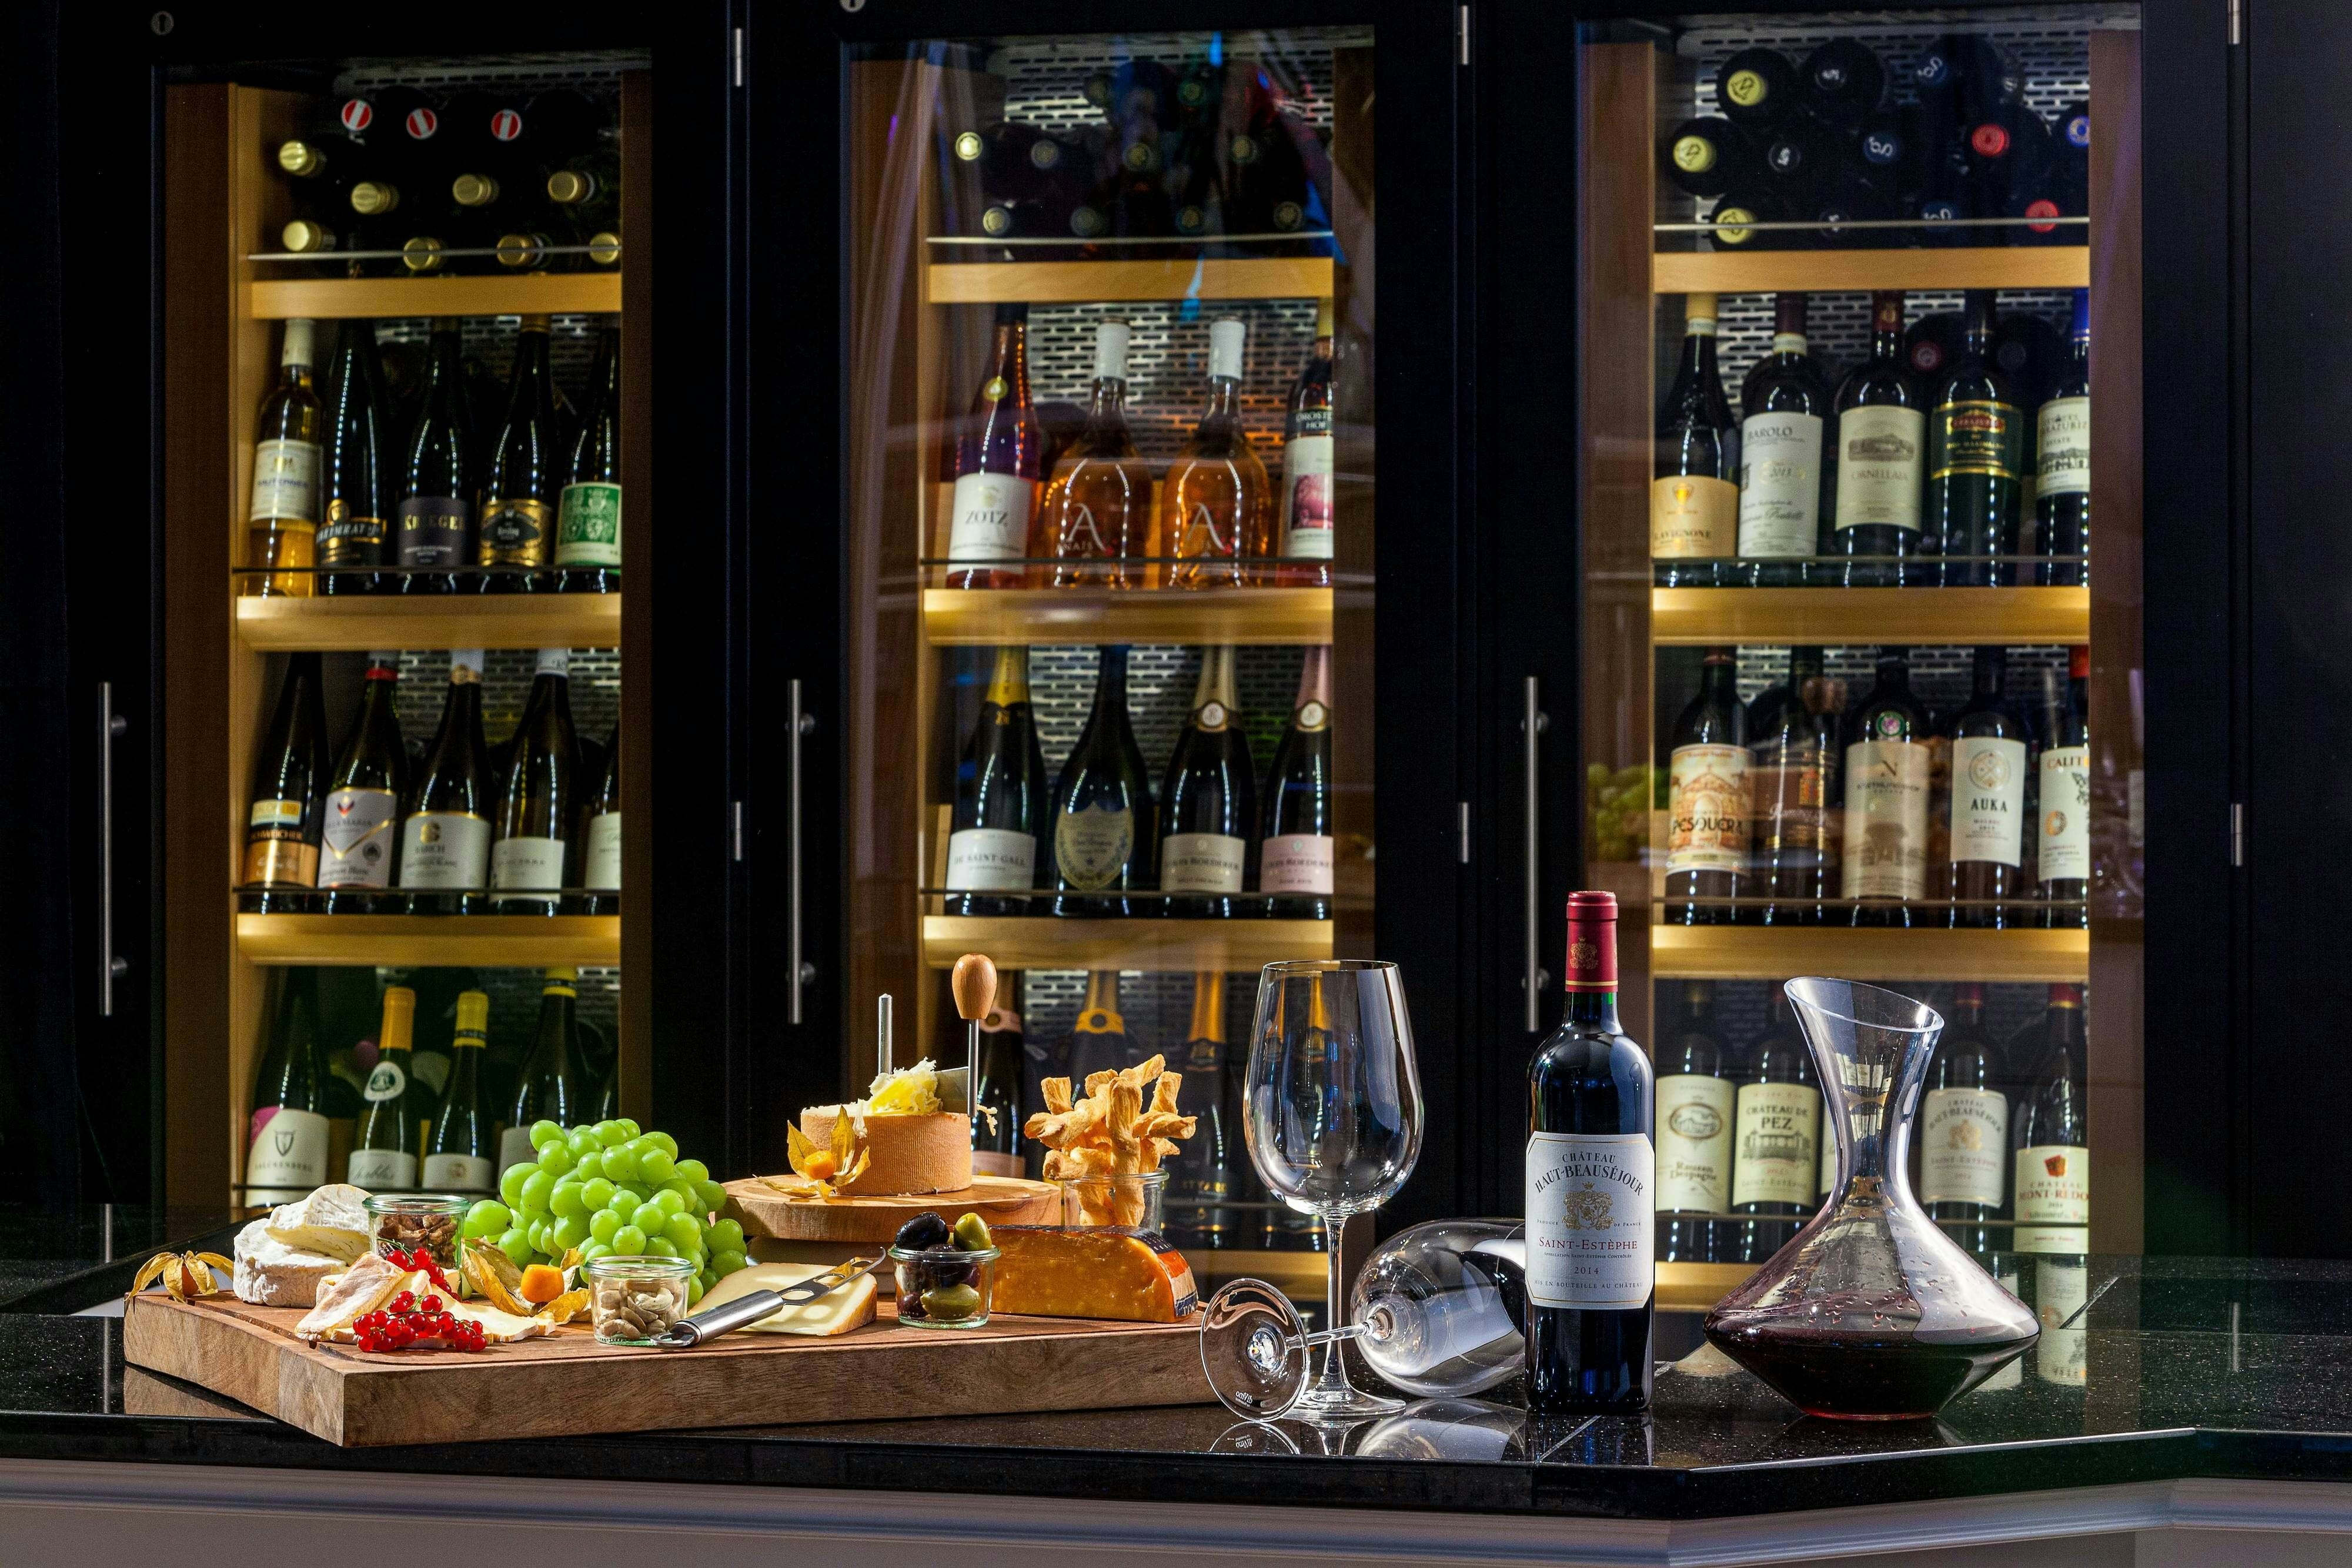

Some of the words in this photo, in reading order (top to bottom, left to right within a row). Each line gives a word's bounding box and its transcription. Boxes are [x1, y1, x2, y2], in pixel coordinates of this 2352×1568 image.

[1747, 426, 1793, 438] BAROLO
[965, 510, 1008, 525] ZOTZ
[1971, 798, 2009, 813] AUKA
[1795, 1106, 1808, 1115] DE
[1761, 1117, 1793, 1130] PEZ
[1562, 1151, 1616, 1164] CHÂTEAU
[1535, 1164, 1643, 1196] HAUT-BEAUSÉJOUR
[1538, 1236, 1638, 1251] SAINT-ESTÈPHE
[1574, 1266, 1599, 1275] 2014
